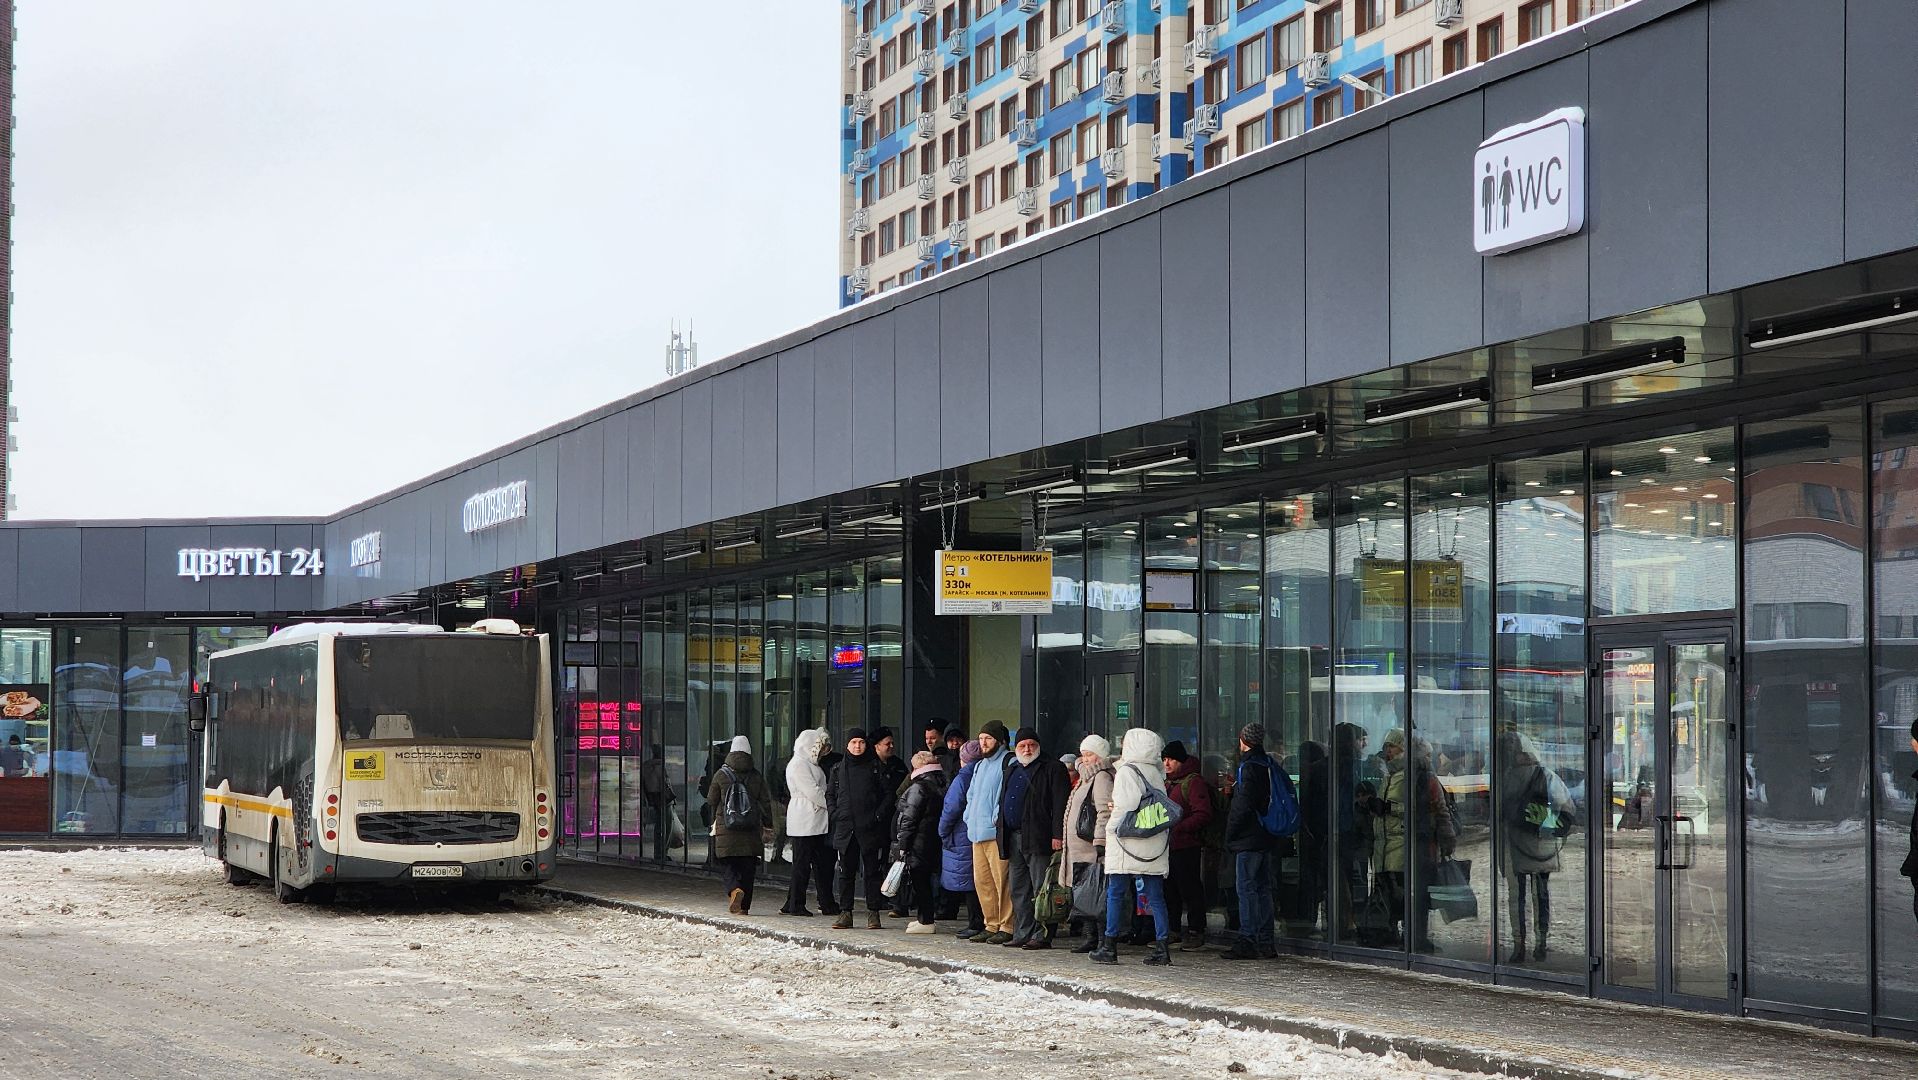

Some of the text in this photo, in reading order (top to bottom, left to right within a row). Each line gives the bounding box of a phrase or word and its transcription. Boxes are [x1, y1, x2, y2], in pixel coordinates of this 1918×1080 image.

[1517, 156, 1562, 213] WC
[464, 480, 528, 533] СТОЛОВАЯ 24
[177, 548, 325, 582] ЦВЕТЫ 24
[944, 553, 1049, 562] Метро «КОТЕЛЬНИКИ»
[960, 567, 966, 576] 1
[395, 752, 482, 760] МОСТРАНСАВТО
[1135, 802, 1169, 828] NIKE
